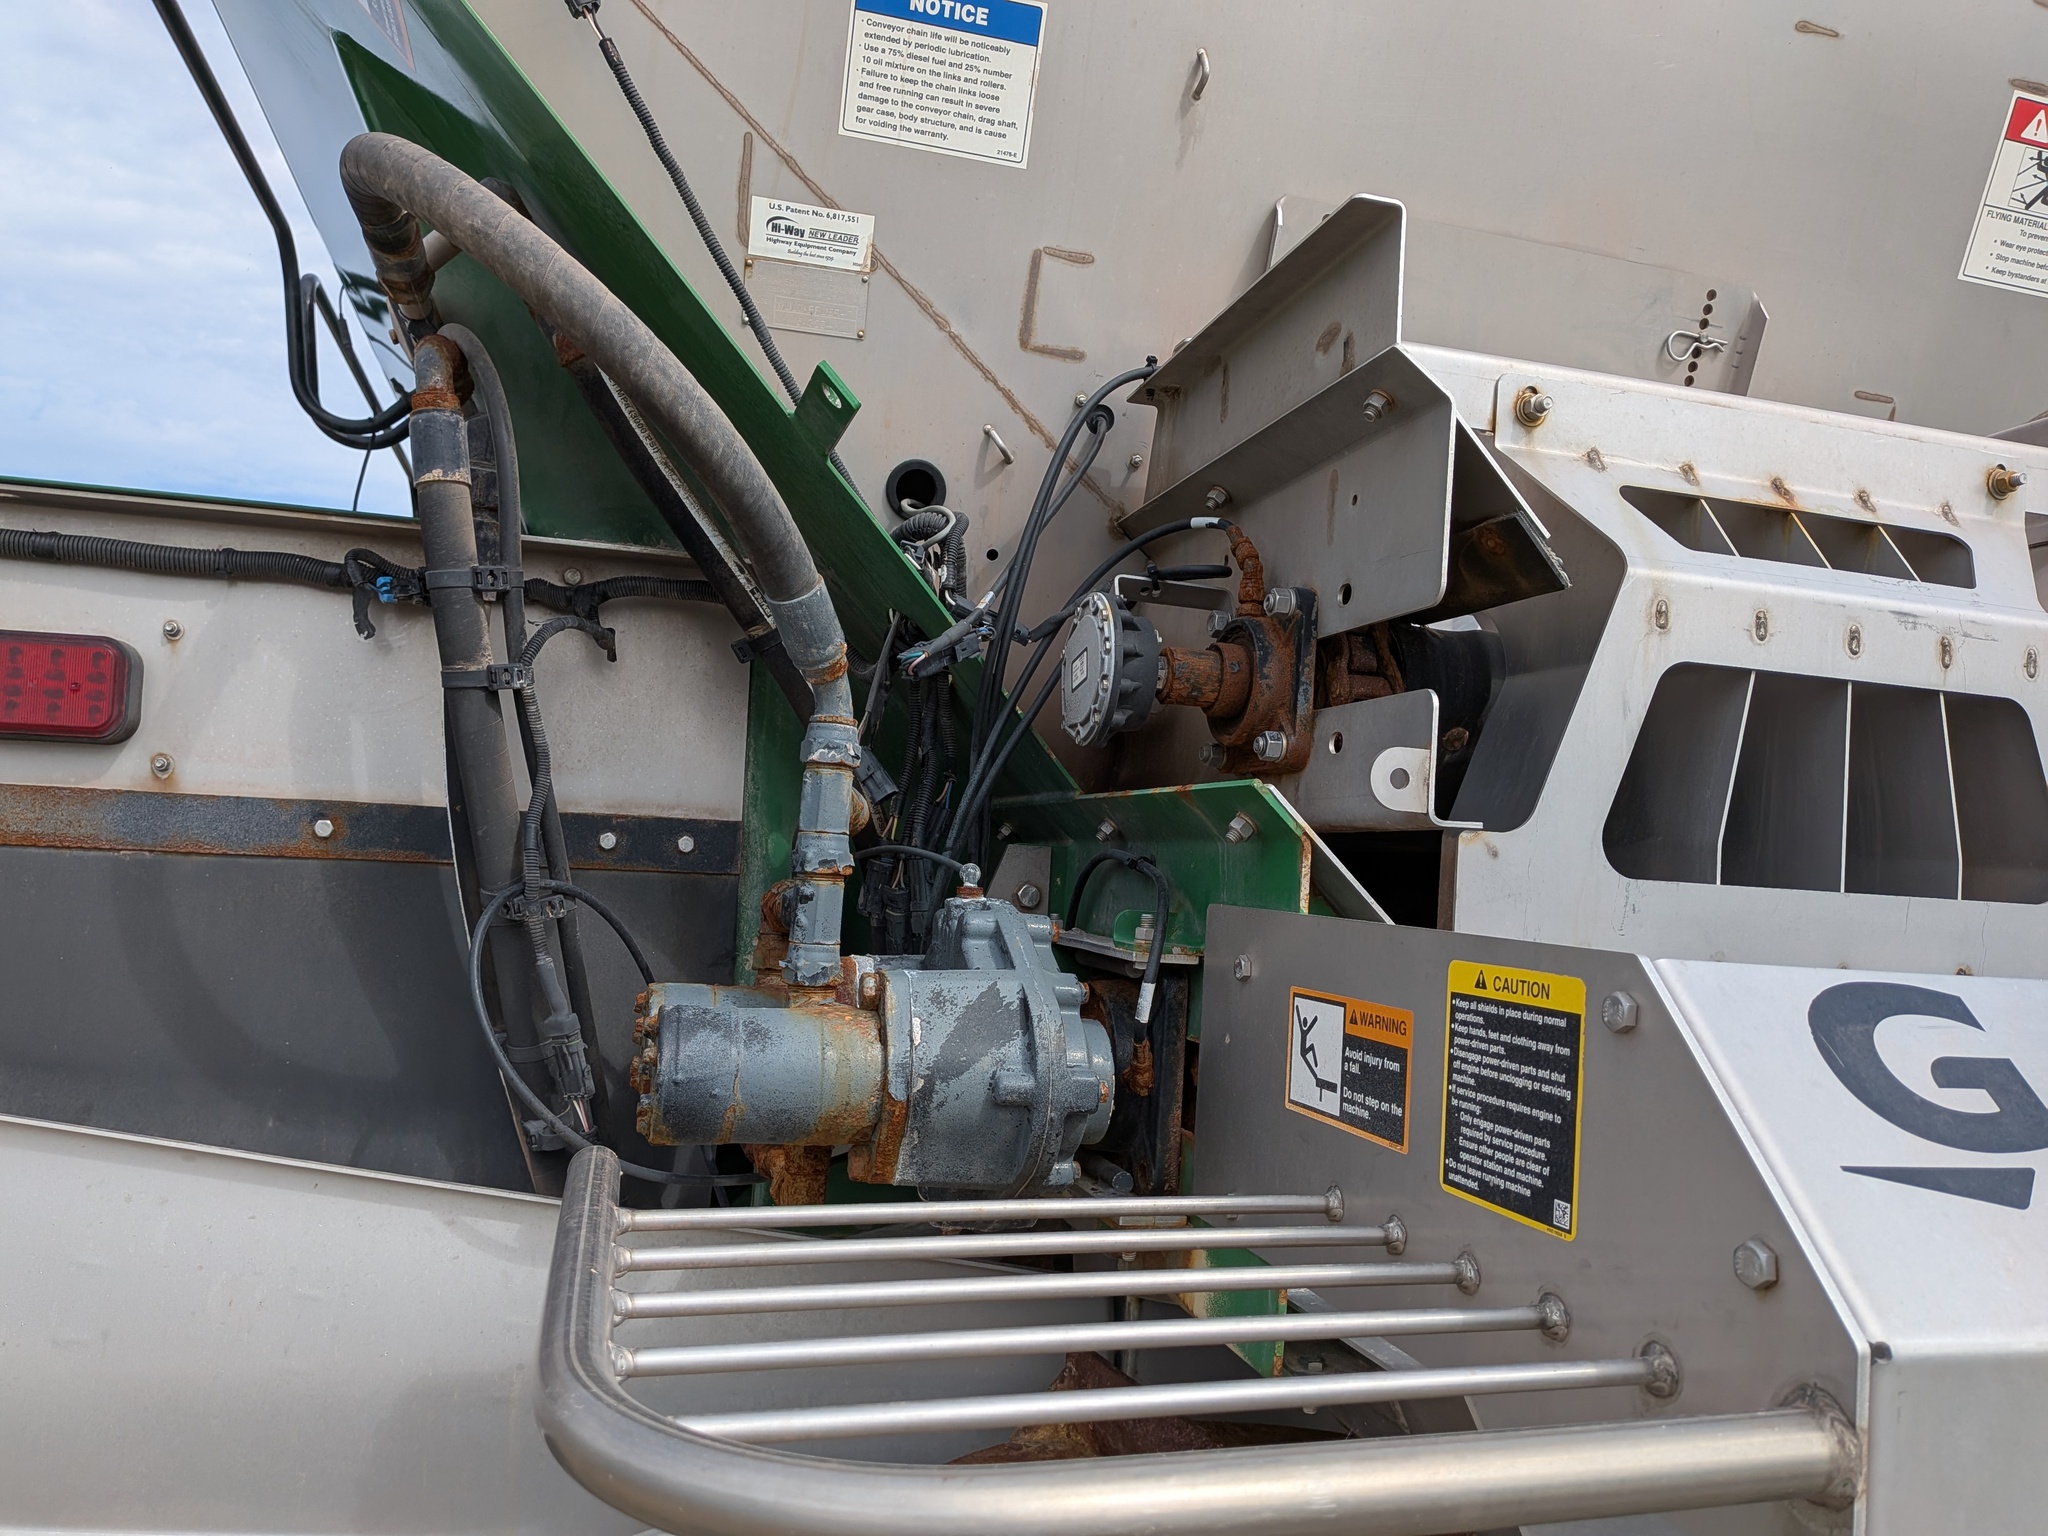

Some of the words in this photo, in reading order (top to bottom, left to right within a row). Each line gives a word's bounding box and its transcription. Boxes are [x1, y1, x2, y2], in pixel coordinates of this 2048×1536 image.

[910, 0, 989, 26] NOTICE
[864, 32, 901, 44] extended
[903, 38, 912, 48] by
[914, 42, 946, 54] periodic
[948, 48, 991, 63] lubrication.
[866, 18, 904, 32] Conveyor
[906, 27, 928, 37] chain
[930, 31, 942, 40] life
[959, 37, 969, 46] be
[971, 41, 1011, 56] noticeably
[864, 43, 879, 52] Use
[888, 48, 904, 58] 75%
[906, 52, 930, 63] diesel
[932, 57, 946, 66] fuel
[965, 64, 981, 73] 25%
[983, 69, 1012, 79] number
[861, 67, 888, 79] Failure
[900, 75, 919, 86] keep
[921, 80, 933, 88] the
[935, 83, 956, 93] chain
[958, 87, 976, 97] links
[979, 91, 1000, 101] loose
[873, 58, 883, 66] oil
[885, 61, 915, 72] mixture
[929, 69, 941, 77] the
[943, 71, 961, 82] links
[963, 77, 978, 85] and
[980, 80, 1006, 90] rollers.
[859, 81, 874, 89] and
[876, 83, 891, 92] free
[893, 88, 923, 100] running
[925, 94, 939, 102] can
[942, 97, 964, 107] result
[966, 100, 973, 108] in
[975, 104, 1000, 113] severe
[857, 105, 874, 113] gear
[876, 109, 896, 119] case,
[899, 112, 918, 123] body
[920, 117, 957, 130] structure,
[984, 130, 1007, 139] cause
[858, 92, 889, 105] damage
[891, 98, 899, 106] to
[901, 100, 913, 109] the
[915, 104, 951, 116] conveyor
[953, 111, 976, 122] chain,
[978, 116, 995, 126] drag
[997, 120, 1018, 130] shaft,
[856, 116, 867, 124] for
[869, 120, 897, 132] voiding
[900, 124, 912, 133] the
[914, 128, 948, 141] warranty.
[769, 203, 784, 211] U.S.
[786, 205, 810, 215] Patent
[812, 210, 825, 218] No.
[826, 212, 859, 223] 6,817,551
[1986, 210, 2012, 222] FLYING
[771, 222, 805, 238] Hi-Way
[809, 230, 827, 238] NEW
[2020, 229, 2027, 237] To
[766, 237, 792, 246] Highway
[794, 241, 827, 251] Equipment
[829, 247, 857, 256] Company
[2000, 240, 2015, 248] Wear
[1995, 253, 2010, 263] Stop
[2010, 258, 2035, 268] machine
[1991, 267, 2007, 277] Keep
[2007, 270, 2040, 283] bystanders
[755, 593, 773, 618] Parker
[1493, 975, 1551, 1000] CAUTION
[1360, 1011, 1407, 1036] WARNING
[1455, 1012, 1485, 1024] operations.
[1456, 998, 1469, 1010] Keep
[1478, 1003, 1498, 1014] shields
[1505, 1008, 1521, 1019] place
[1523, 1010, 1543, 1025] during
[1544, 1016, 1566, 1027] normal
[1454, 1037, 1489, 1050] power-driven
[1489, 1045, 1506, 1055] parts.
[1455, 1023, 1468, 1035] Keep
[1469, 1025, 1487, 1039] hands,
[1488, 1029, 1499, 1040] feet
[1500, 1034, 1511, 1043] and
[1512, 1035, 1536, 1051] clothing
[1537, 1042, 1554, 1054] away
[1555, 1044, 1570, 1056] from
[1344, 1062, 1348, 1070] a
[1349, 1061, 1361, 1074] fall.
[1345, 1047, 1363, 1061] Avoid
[1364, 1052, 1383, 1070] injury
[1384, 1057, 1400, 1072] from
[1454, 1047, 1481, 1063] Disengage
[1482, 1056, 1519, 1071] power-driven
[1520, 1065, 1536, 1076] parts
[1538, 1069, 1550, 1079] and
[1551, 1071, 1566, 1083] shut
[1453, 1073, 1476, 1086] machine.
[1453, 1060, 1461, 1069] off
[1461, 1063, 1479, 1074] engine
[1480, 1066, 1498, 1079] before
[1499, 1073, 1532, 1090] unclogging
[1541, 1084, 1571, 1101] servicing
[1343, 1086, 1352, 1099] Do
[1353, 1092, 1364, 1103] not
[1365, 1096, 1379, 1111] step
[1381, 1102, 1389, 1112] on
[1391, 1103, 1402, 1117] the
[1343, 1102, 1371, 1120] machine.
[1457, 1087, 1476, 1099] service
[1477, 1093, 1505, 1107] procedure
[1506, 1101, 1531, 1115] requires
[1532, 1108, 1553, 1121] engine
[1459, 1100, 1482, 1115] running:
[1460, 1111, 1473, 1125] Only
[1473, 1118, 1494, 1131] engage
[1495, 1124, 1533, 1143] power-driven
[1534, 1137, 1550, 1148] parts
[1459, 1136, 1478, 1151] Ensure
[1479, 1145, 1494, 1156] other
[1495, 1151, 1514, 1164] people
[1515, 1158, 1525, 1167] are
[1526, 1160, 1542, 1173] clear
[1461, 1126, 1483, 1140] required
[1492, 1137, 1513, 1150] service
[1514, 1144, 1547, 1161] procedure.
[1449, 1158, 1456, 1168] Do
[1457, 1163, 1466, 1173] not
[1467, 1165, 1482, 1178] leave
[1482, 1172, 1504, 1189] running
[1505, 1181, 1531, 1197] machine
[1449, 1172, 1479, 1190] unattended.
[1460, 1151, 1482, 1165] operator
[1483, 1159, 1503, 1173] station
[1504, 1167, 1515, 1177] and
[1516, 1172, 1544, 1188] machine.
